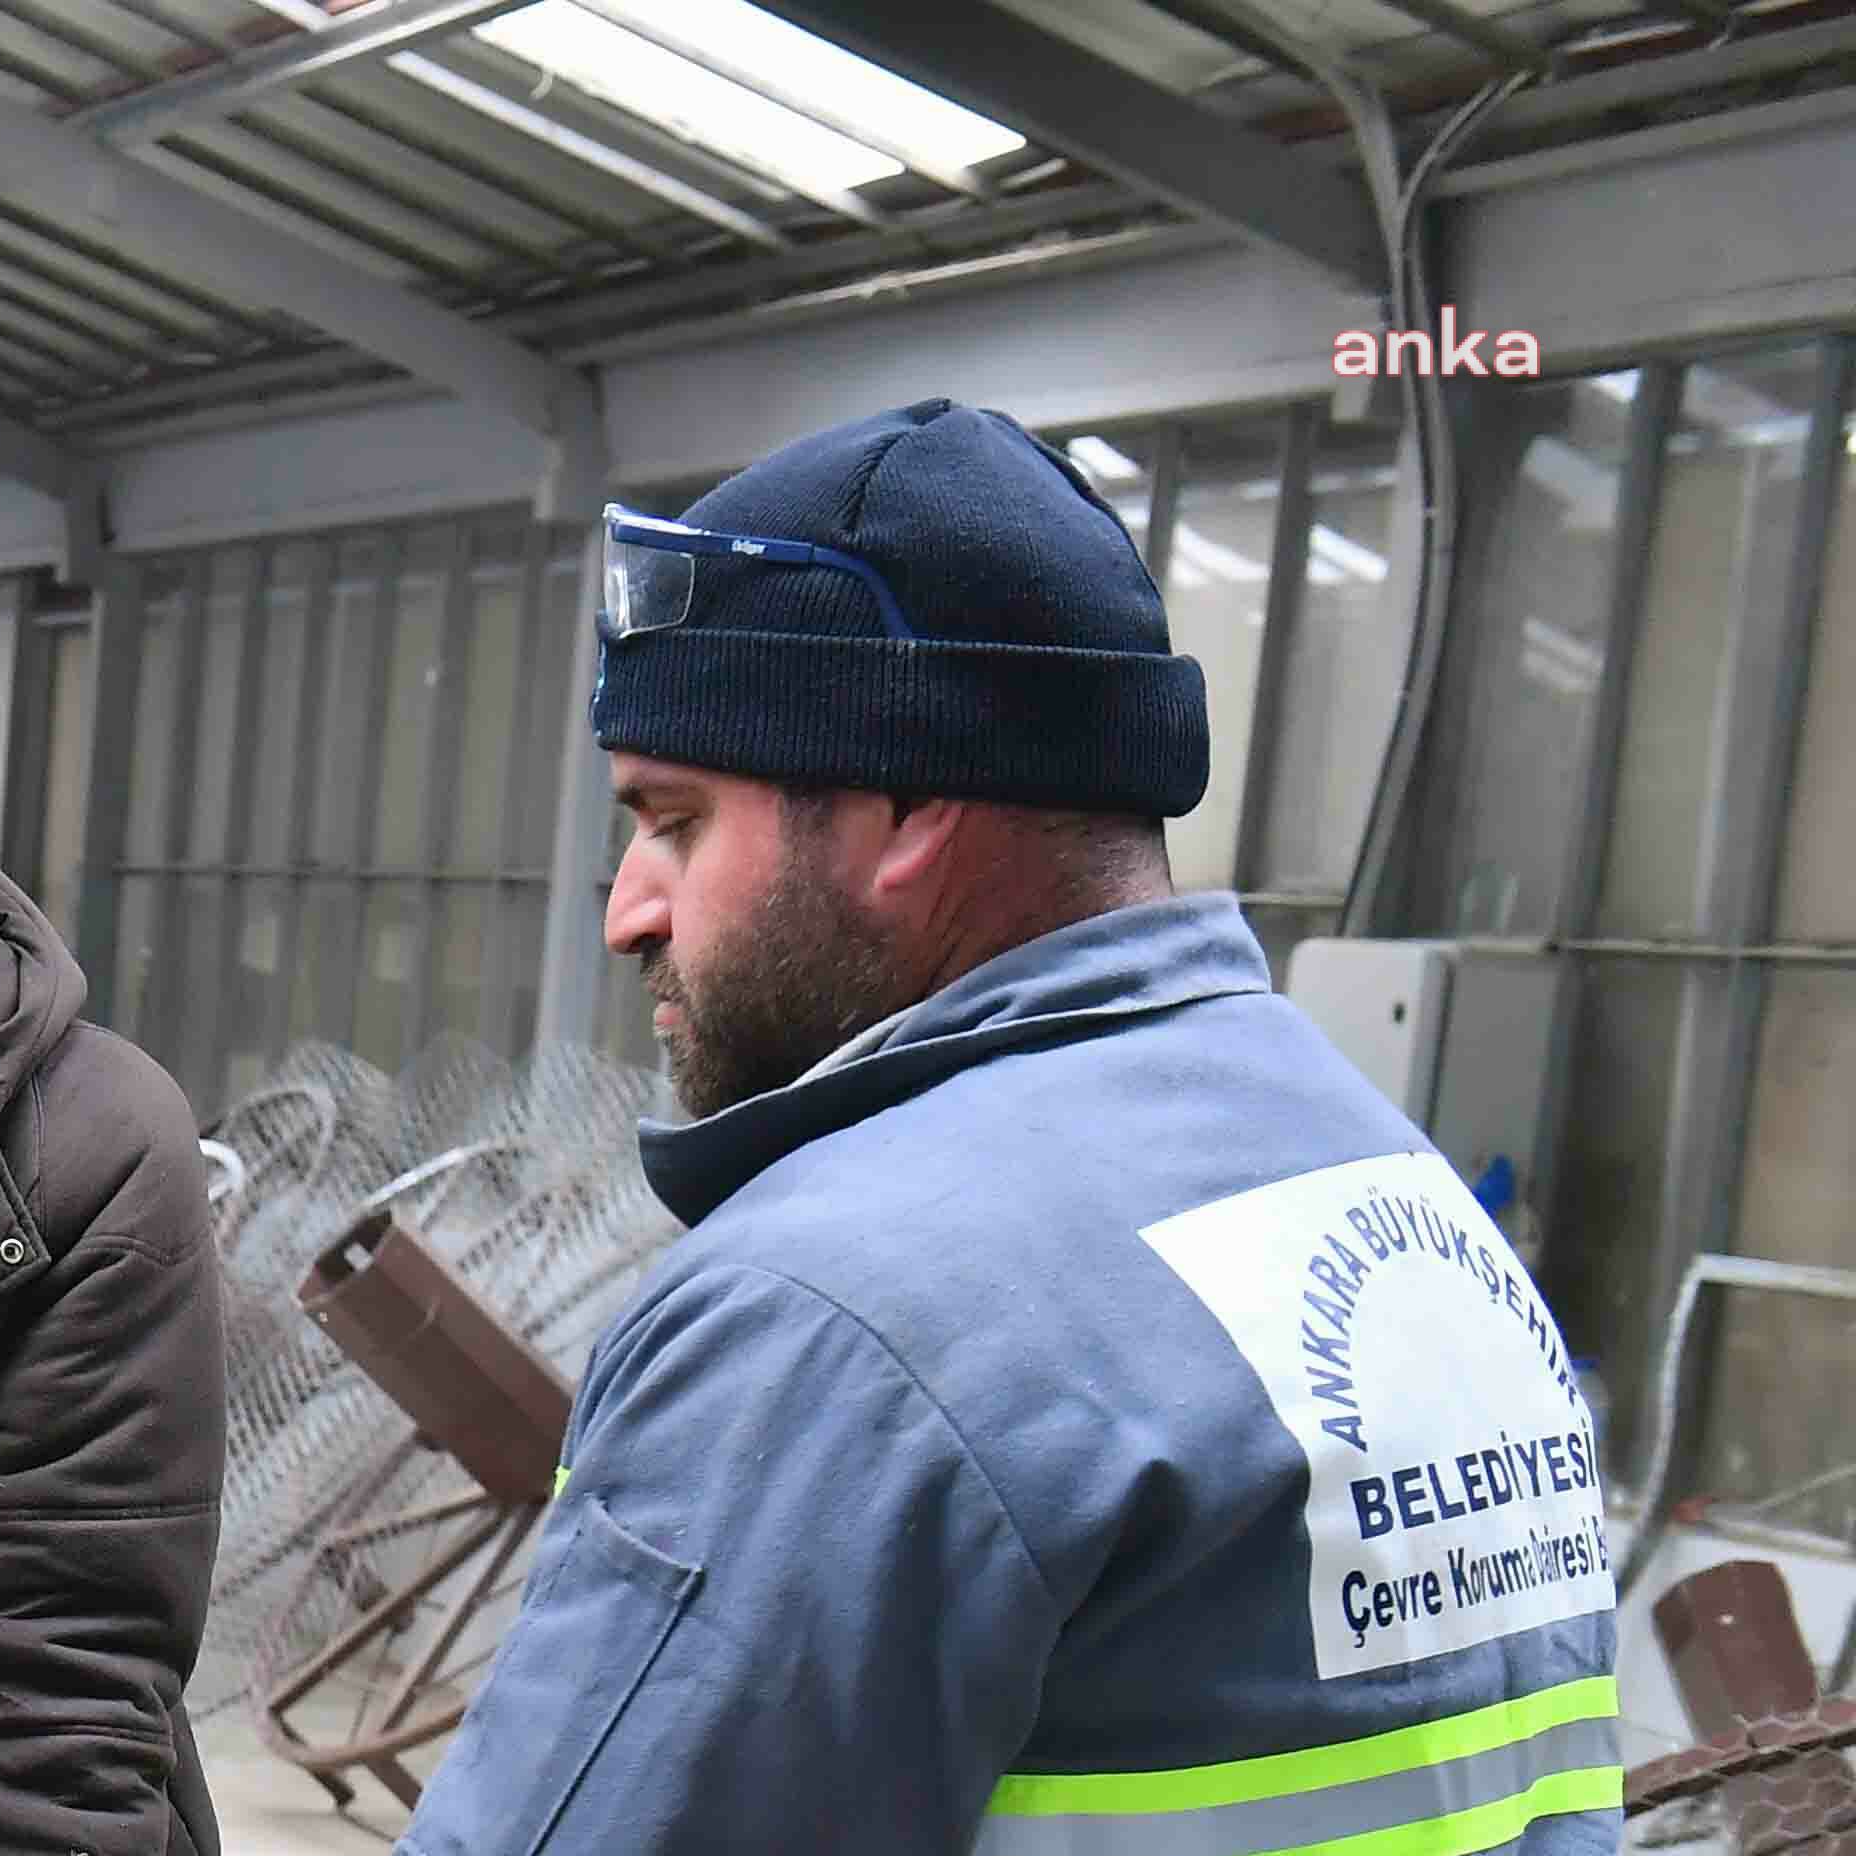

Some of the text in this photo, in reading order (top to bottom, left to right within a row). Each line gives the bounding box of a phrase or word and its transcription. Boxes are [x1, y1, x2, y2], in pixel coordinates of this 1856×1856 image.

[1303, 1234, 1372, 1454] ANKARA
[1350, 1417, 1596, 1540] BELEDİYESİ
[1341, 1568, 1443, 1648] Çevre
